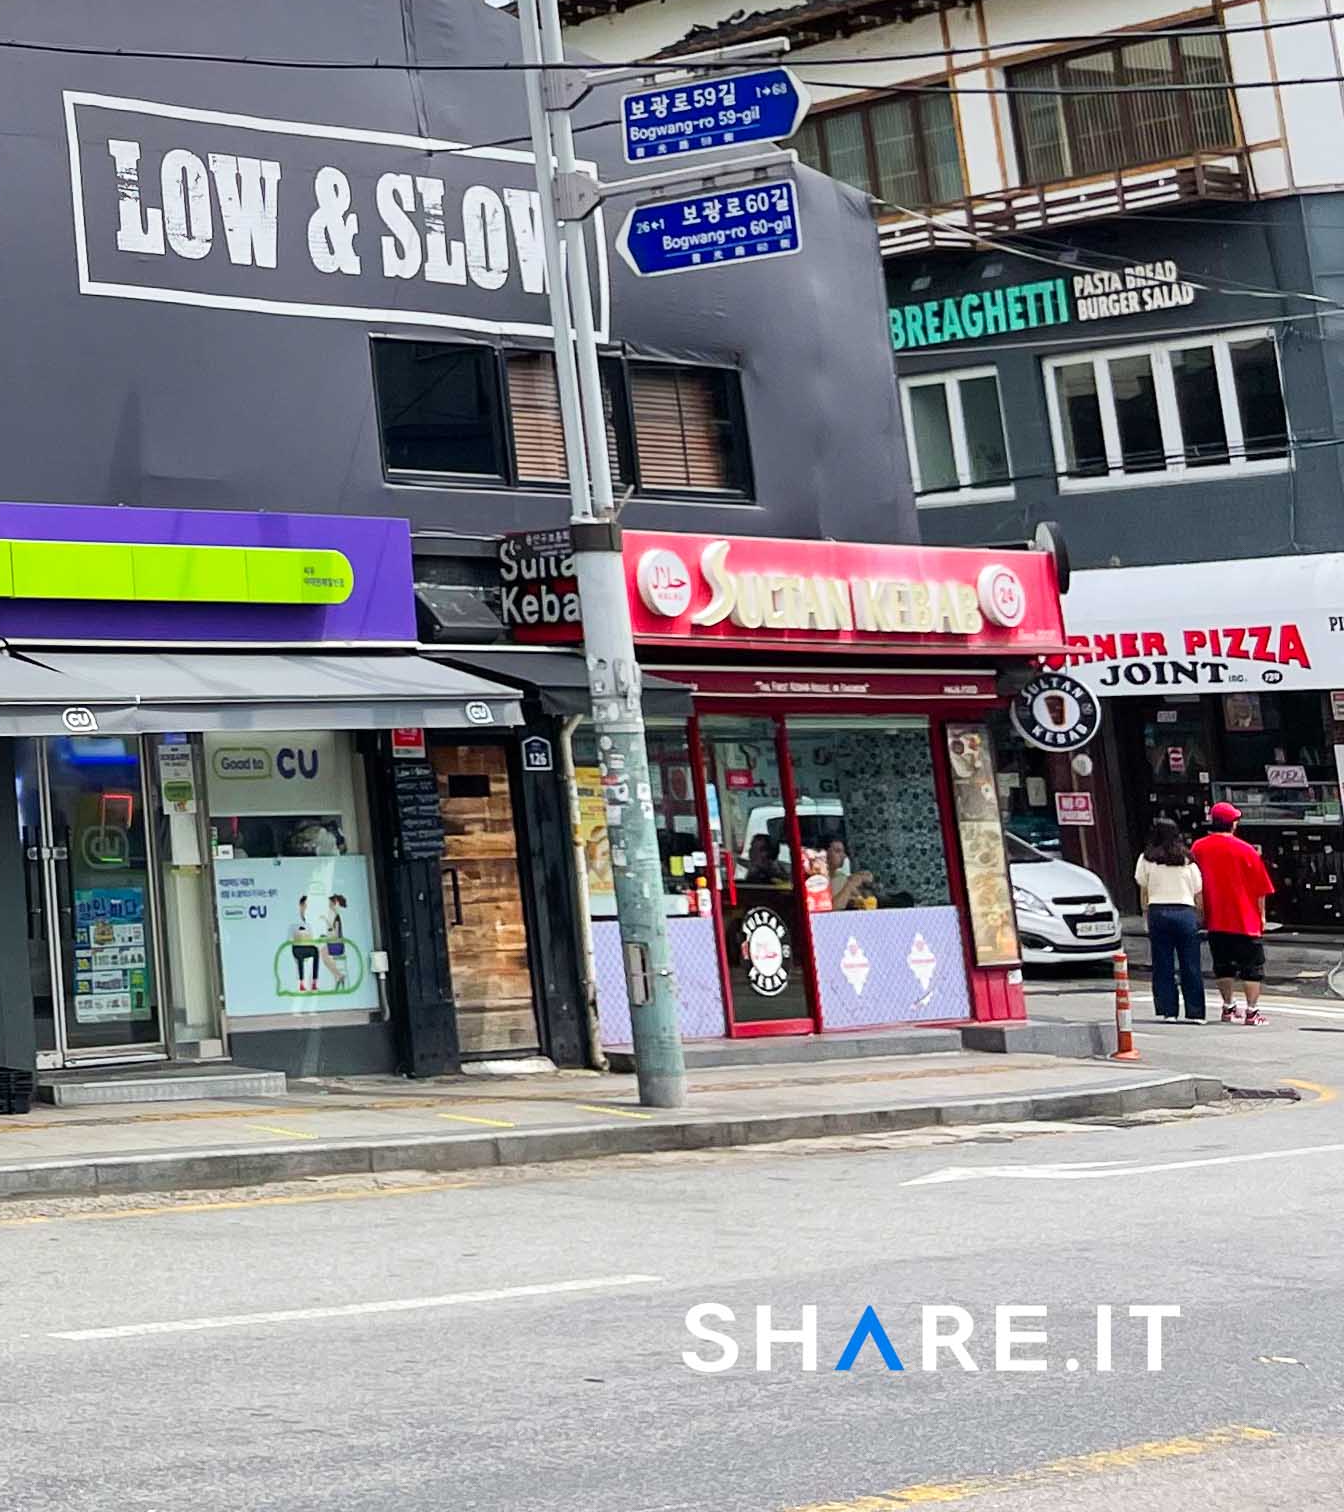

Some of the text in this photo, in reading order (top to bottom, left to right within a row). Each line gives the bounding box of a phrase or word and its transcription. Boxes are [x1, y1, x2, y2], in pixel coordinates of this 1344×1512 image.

[629, 81, 737, 121] 보광로59길
[630, 105, 761, 142] Bogwang-ro 59-gil
[107, 138, 568, 295] LOW & SLOW
[681, 186, 790, 226] 보광로60길
[663, 215, 793, 251] Bogwang-ro 60-gil
[1073, 260, 1177, 297] PASTA BREAD
[888, 278, 1070, 350] BREAGHETTI
[1077, 283, 1195, 322] BURGER SALAD
[500, 541, 578, 581] Sulta
[501, 584, 582, 624] Keba
[690, 539, 983, 634] SULTAN KEBAB
[1183, 624, 1312, 669] PIZZA
[1021, 674, 1083, 707] SULTAN
[1100, 660, 1229, 686] JOINT
[66, 711, 90, 726] CU
[469, 703, 487, 717] CU
[1031, 722, 1089, 745] KEBAB
[221, 747, 319, 780] Good to CU
[529, 752, 548, 766] 126
[248, 904, 268, 919] CU
